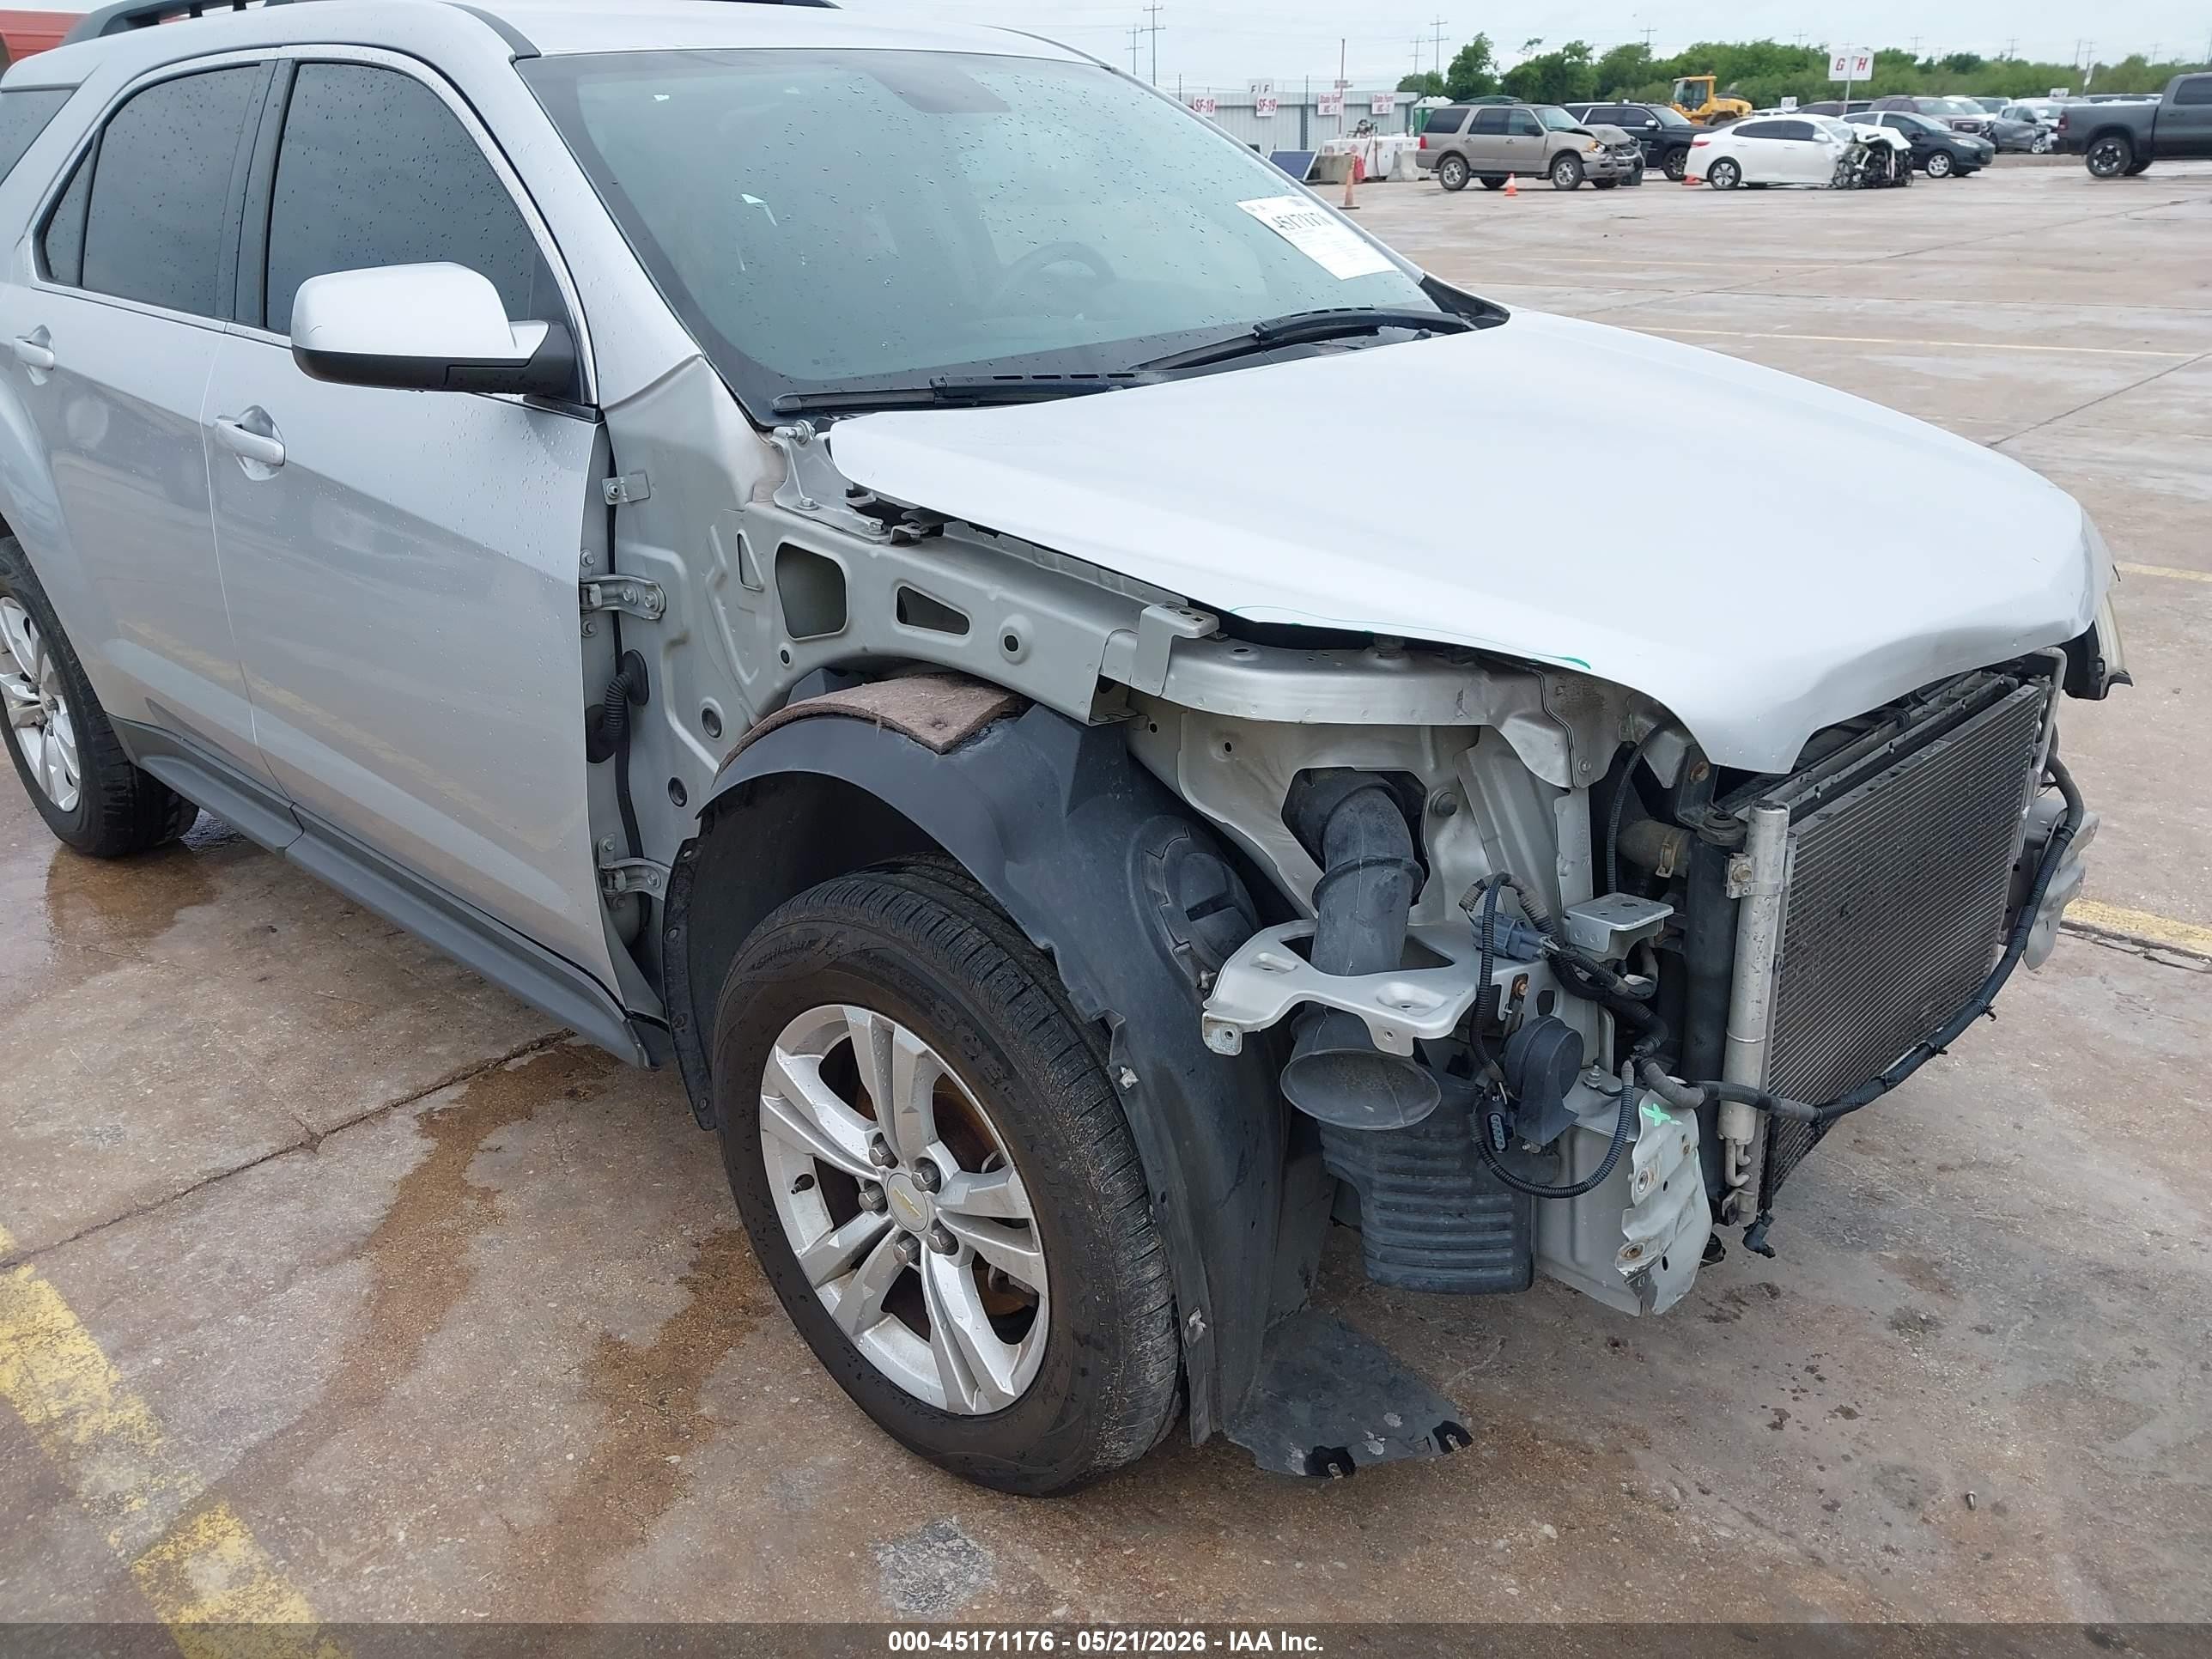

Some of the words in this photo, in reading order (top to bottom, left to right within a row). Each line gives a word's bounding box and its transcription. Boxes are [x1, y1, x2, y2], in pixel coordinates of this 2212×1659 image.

[1836, 58, 1846, 71] G
[1856, 58, 1869, 71] H
[1258, 98, 1277, 112] SF-19
